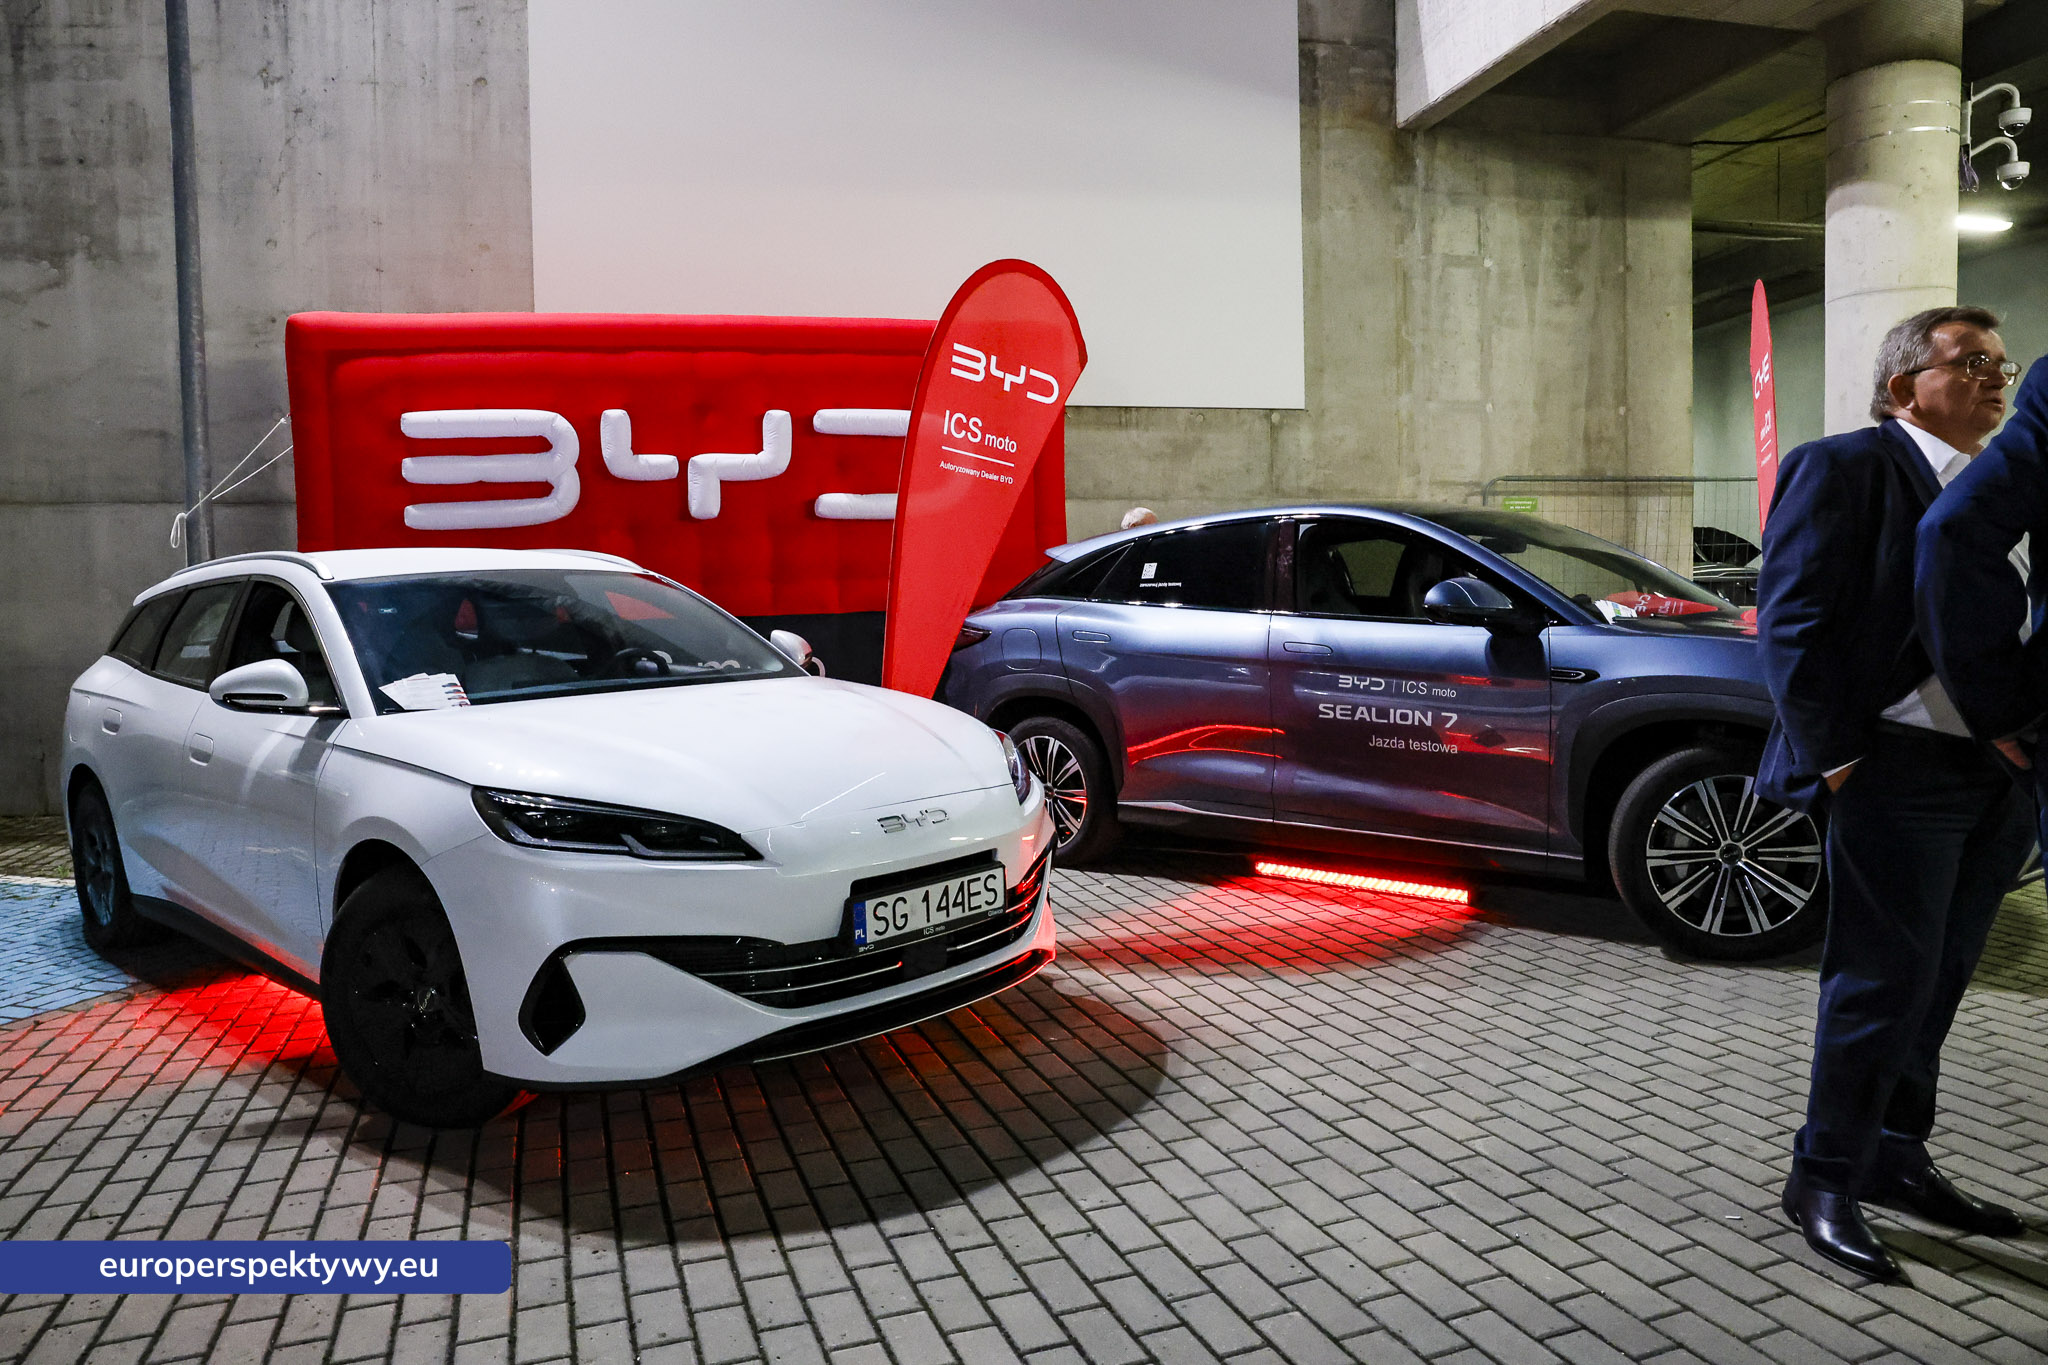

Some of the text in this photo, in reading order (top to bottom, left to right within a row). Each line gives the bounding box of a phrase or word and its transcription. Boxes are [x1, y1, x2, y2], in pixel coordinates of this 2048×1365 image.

[951, 342, 1060, 404] BYD
[943, 409, 1017, 453] ICS moto
[939, 460, 1014, 485] Autoryzowany Dealer BYD
[1338, 674, 1457, 698] BYD ICS moto
[1318, 703, 1458, 728] SEALION 7
[1368, 735, 1458, 754] Jazda testowa
[877, 808, 949, 834] BYD
[873, 873, 998, 937] SG 144ES
[855, 928, 866, 940] PL
[923, 926, 935, 936] ICS
